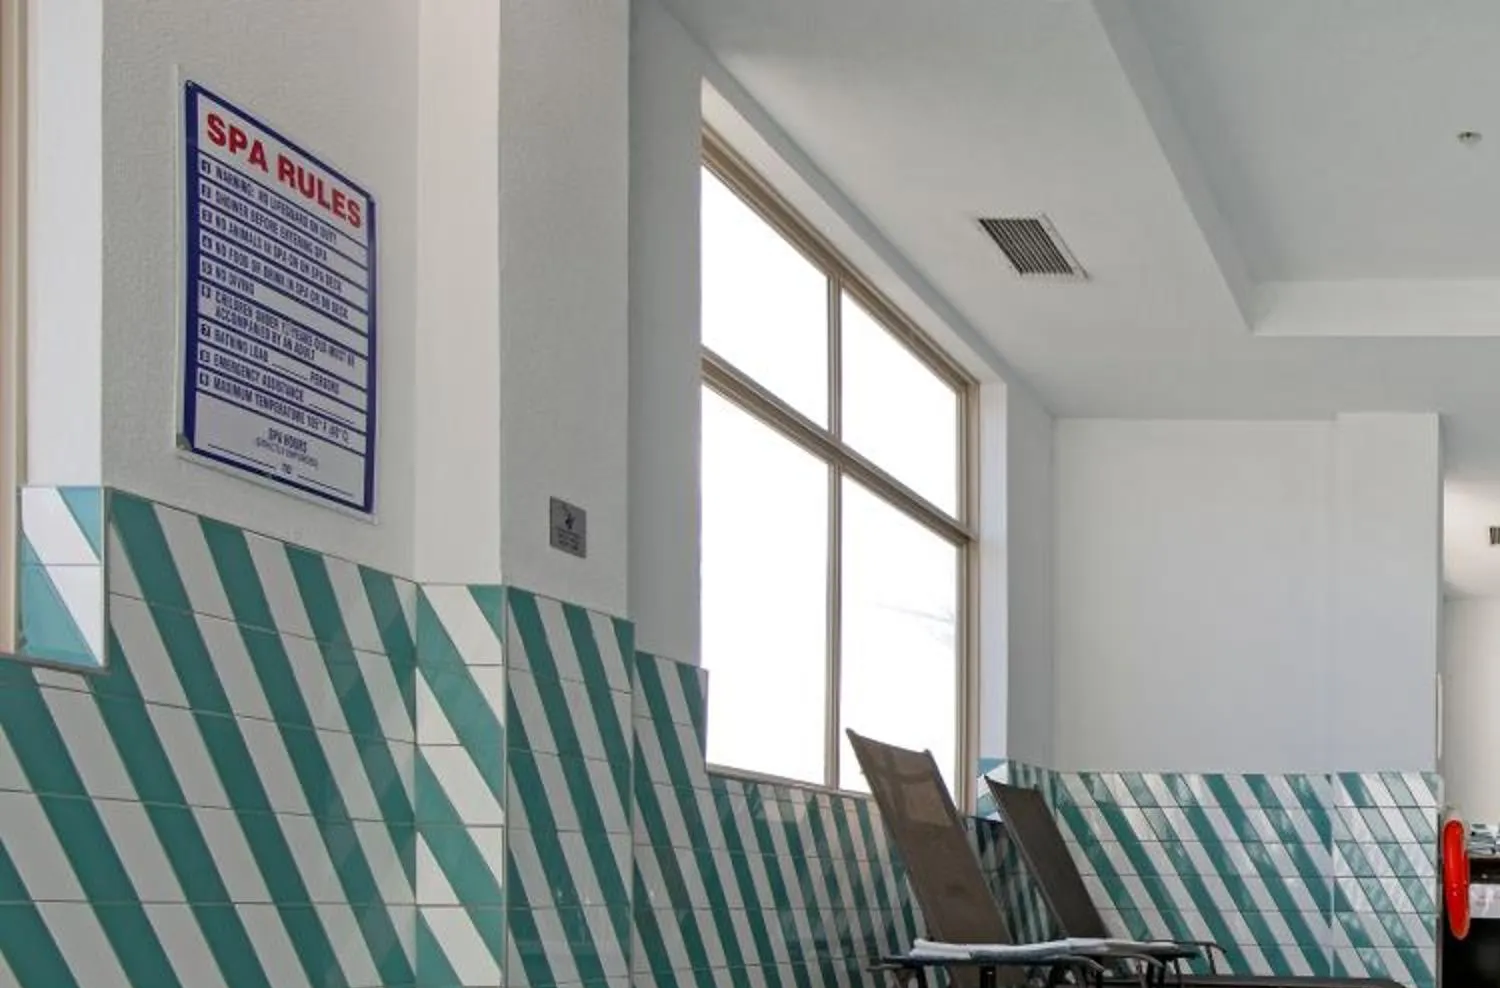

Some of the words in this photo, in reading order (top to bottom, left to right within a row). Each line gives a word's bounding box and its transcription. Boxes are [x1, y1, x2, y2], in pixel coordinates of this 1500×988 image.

[206, 113, 269, 173] SPA
[277, 153, 361, 228] RULES
[215, 188, 248, 218] SHOWER
[251, 209, 277, 234] BEFORE
[280, 225, 312, 254] ENTERING
[314, 245, 326, 262] SPA
[215, 213, 225, 230] NO
[228, 220, 261, 250] ANIMALS
[273, 245, 286, 263] SPA
[311, 266, 323, 283] SPA
[325, 274, 341, 293] DECK
[215, 240, 225, 256] NO
[228, 247, 248, 268] FOOD
[263, 265, 283, 287] DRINK
[295, 282, 308, 299] SPA
[331, 301, 348, 320] DECK
[215, 265, 225, 282] NO
[228, 272, 254, 296] DIVING
[215, 289, 252, 318] CHILDREN
[255, 309, 277, 330] UNDER
[214, 327, 247, 353] BATHING
[249, 343, 268, 362] LOAD
[309, 371, 339, 394] PERSONS
[215, 304, 270, 341] ACCOMPANIED
[271, 331, 280, 345] BY
[282, 336, 292, 351] AN
[294, 341, 314, 361] ADULT
[214, 353, 259, 383] EMERGENCY
[262, 373, 303, 402] ASSISTANCE
[214, 376, 252, 403] MAXIMUM
[255, 393, 304, 424] TEMPERATURE
